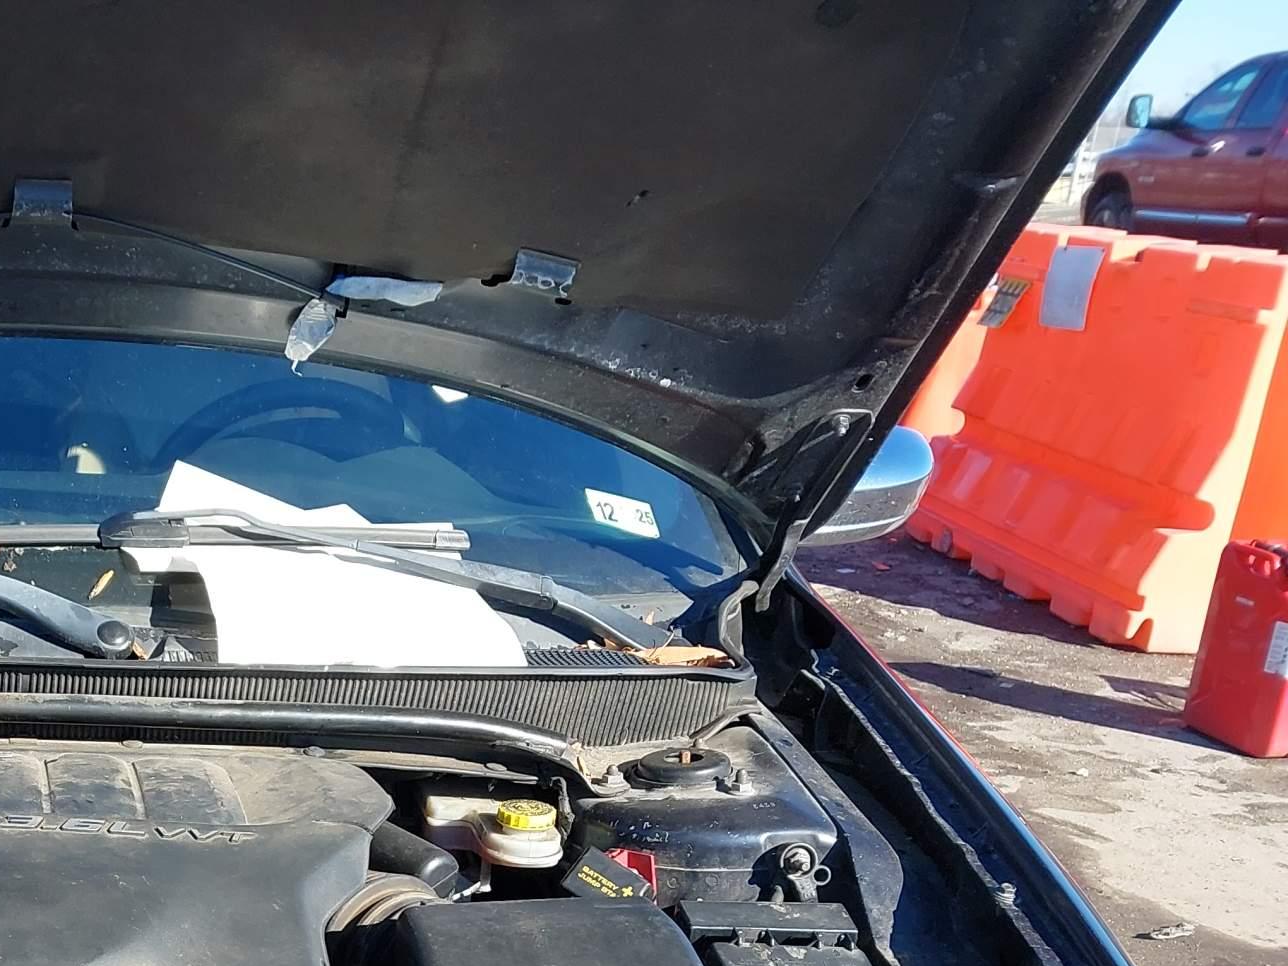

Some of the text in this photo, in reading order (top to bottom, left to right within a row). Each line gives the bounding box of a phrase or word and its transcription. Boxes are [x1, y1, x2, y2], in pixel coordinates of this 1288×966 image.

[596, 501, 654, 526] 12 25
[153, 825, 258, 844] VVT
[577, 872, 601, 889] JUMP
[581, 865, 620, 891] BATTERY
